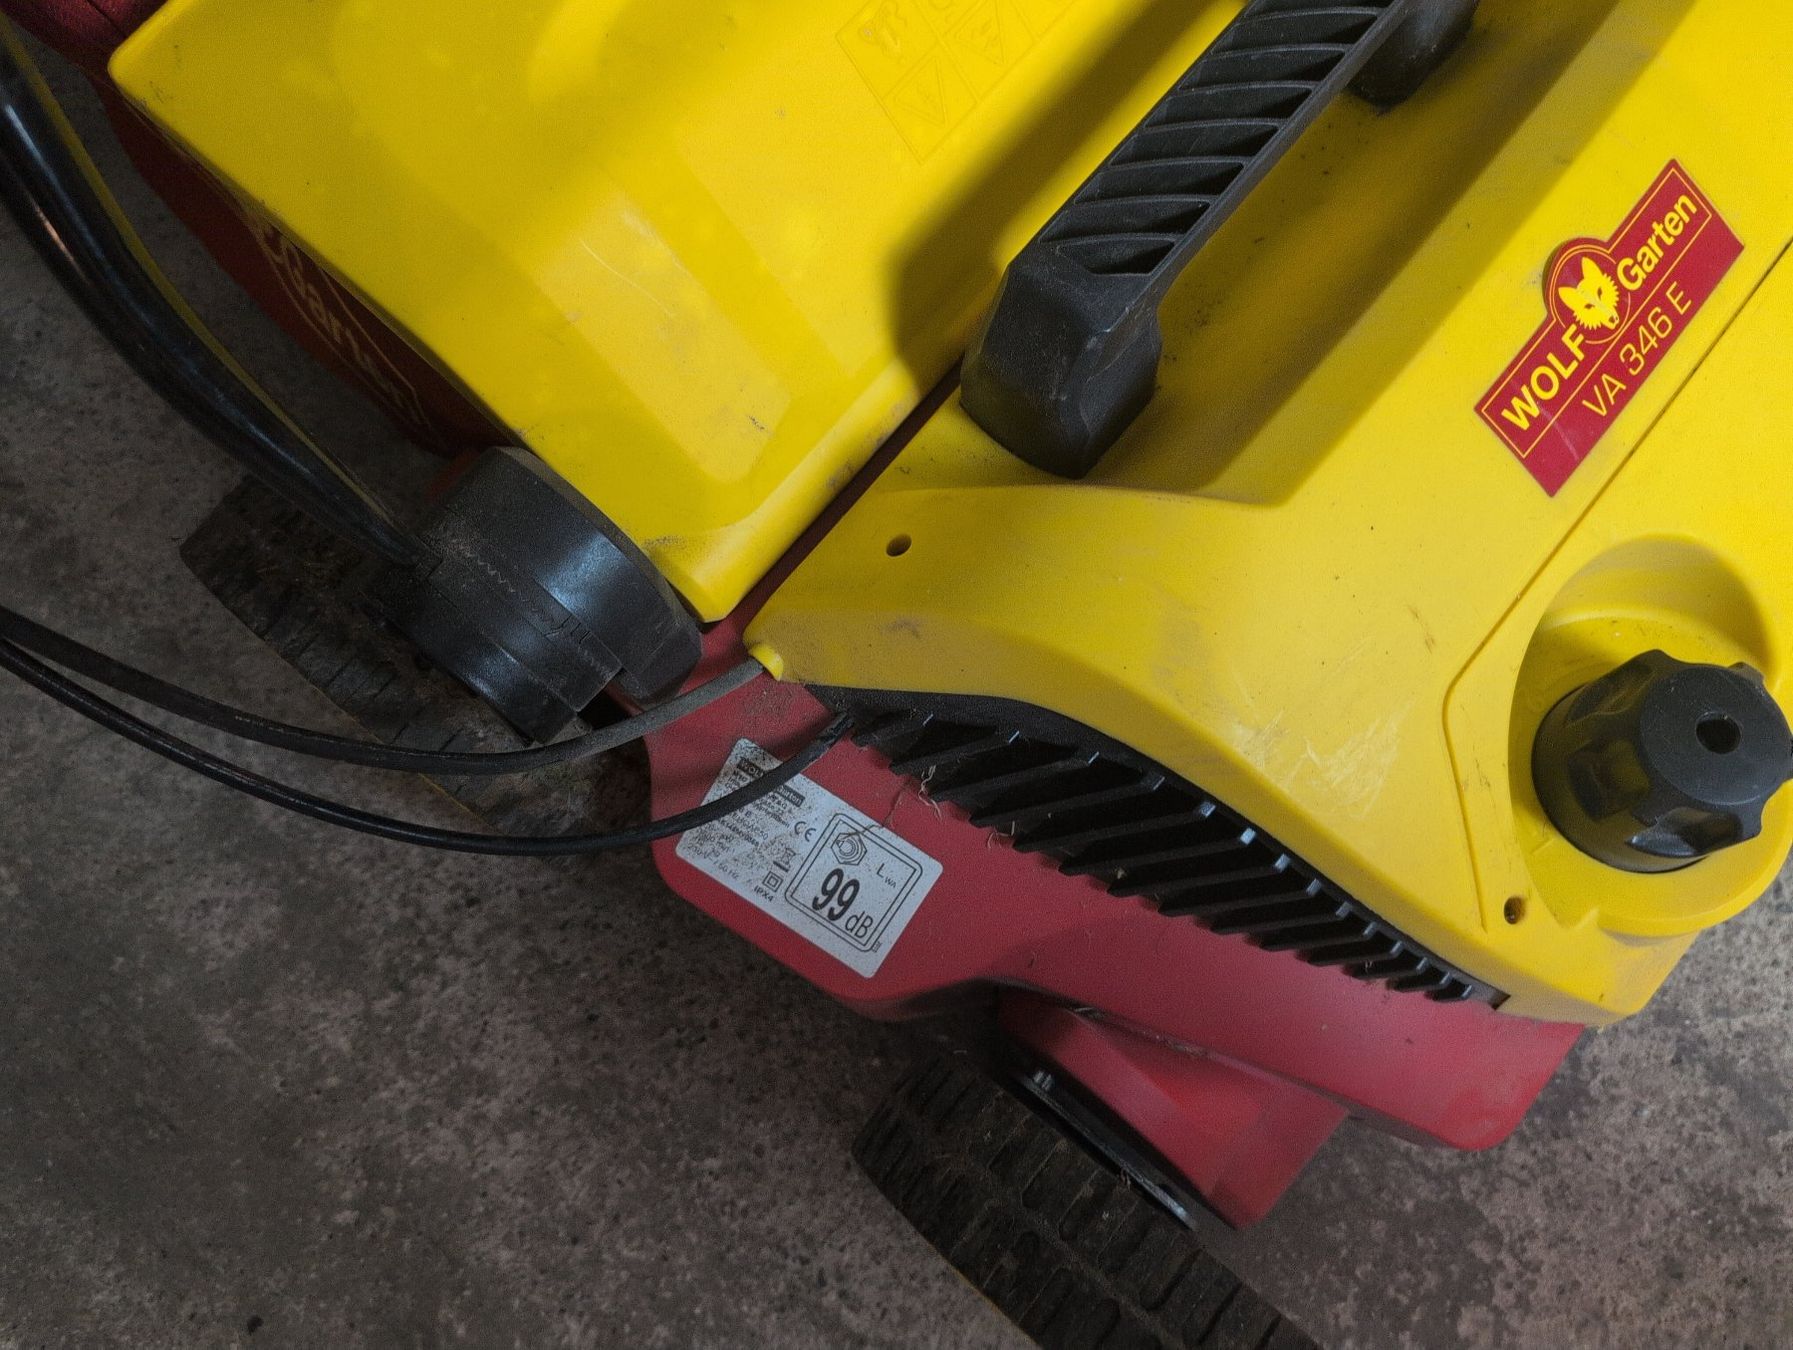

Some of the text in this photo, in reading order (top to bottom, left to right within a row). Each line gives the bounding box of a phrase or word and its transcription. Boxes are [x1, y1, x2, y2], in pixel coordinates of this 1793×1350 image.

[1501, 194, 1698, 430] WOLF Garten
[1581, 280, 1692, 417] VA 346 E
[753, 884, 774, 902] IPX4
[811, 867, 874, 939] 99 dB
